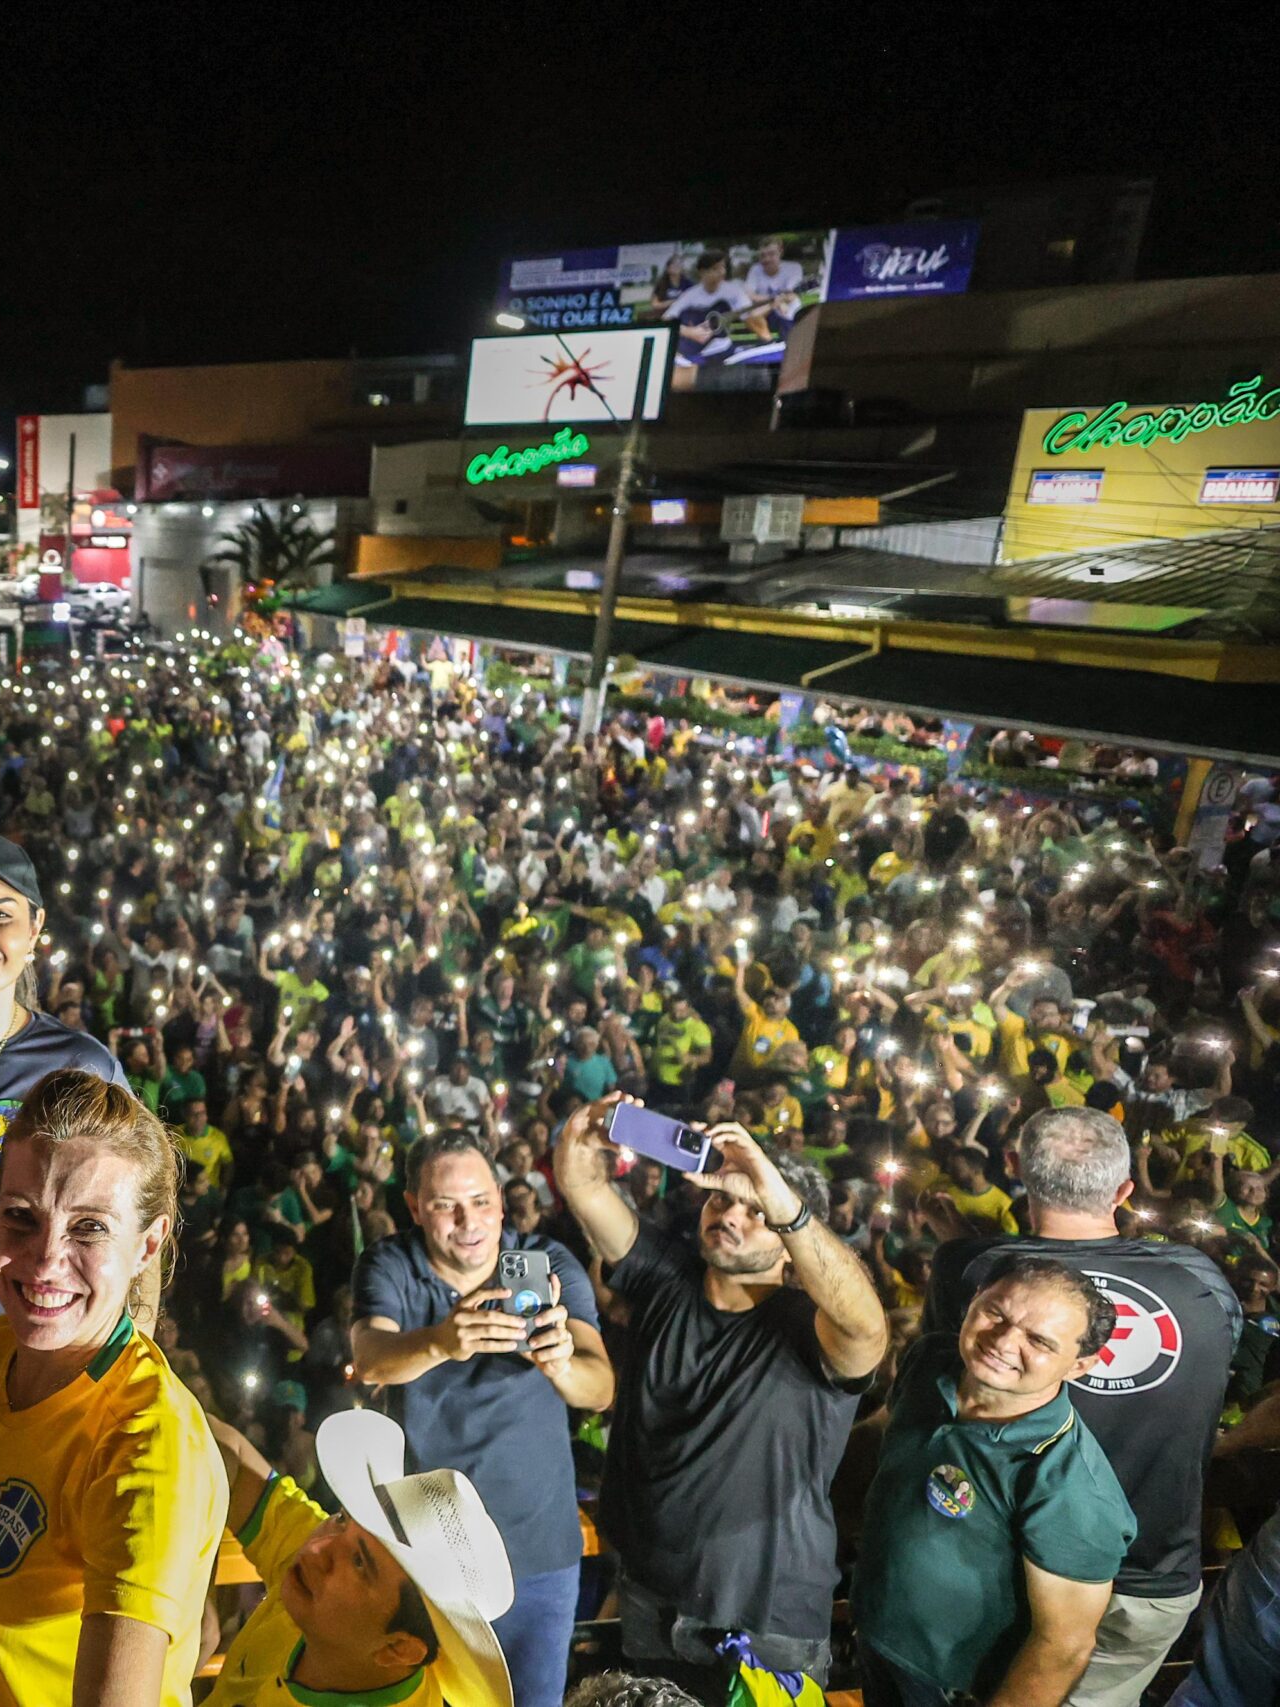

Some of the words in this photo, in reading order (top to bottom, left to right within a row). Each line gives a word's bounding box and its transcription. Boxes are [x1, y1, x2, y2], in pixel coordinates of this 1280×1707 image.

[526, 292, 588, 311] SONHO
[588, 288, 601, 309] É
[601, 291, 615, 307] A
[562, 309, 599, 327] QUE
[600, 307, 633, 324] FAZ
[1107, 1377, 1136, 1390] JITSU
[943, 1497, 961, 1517] 22
